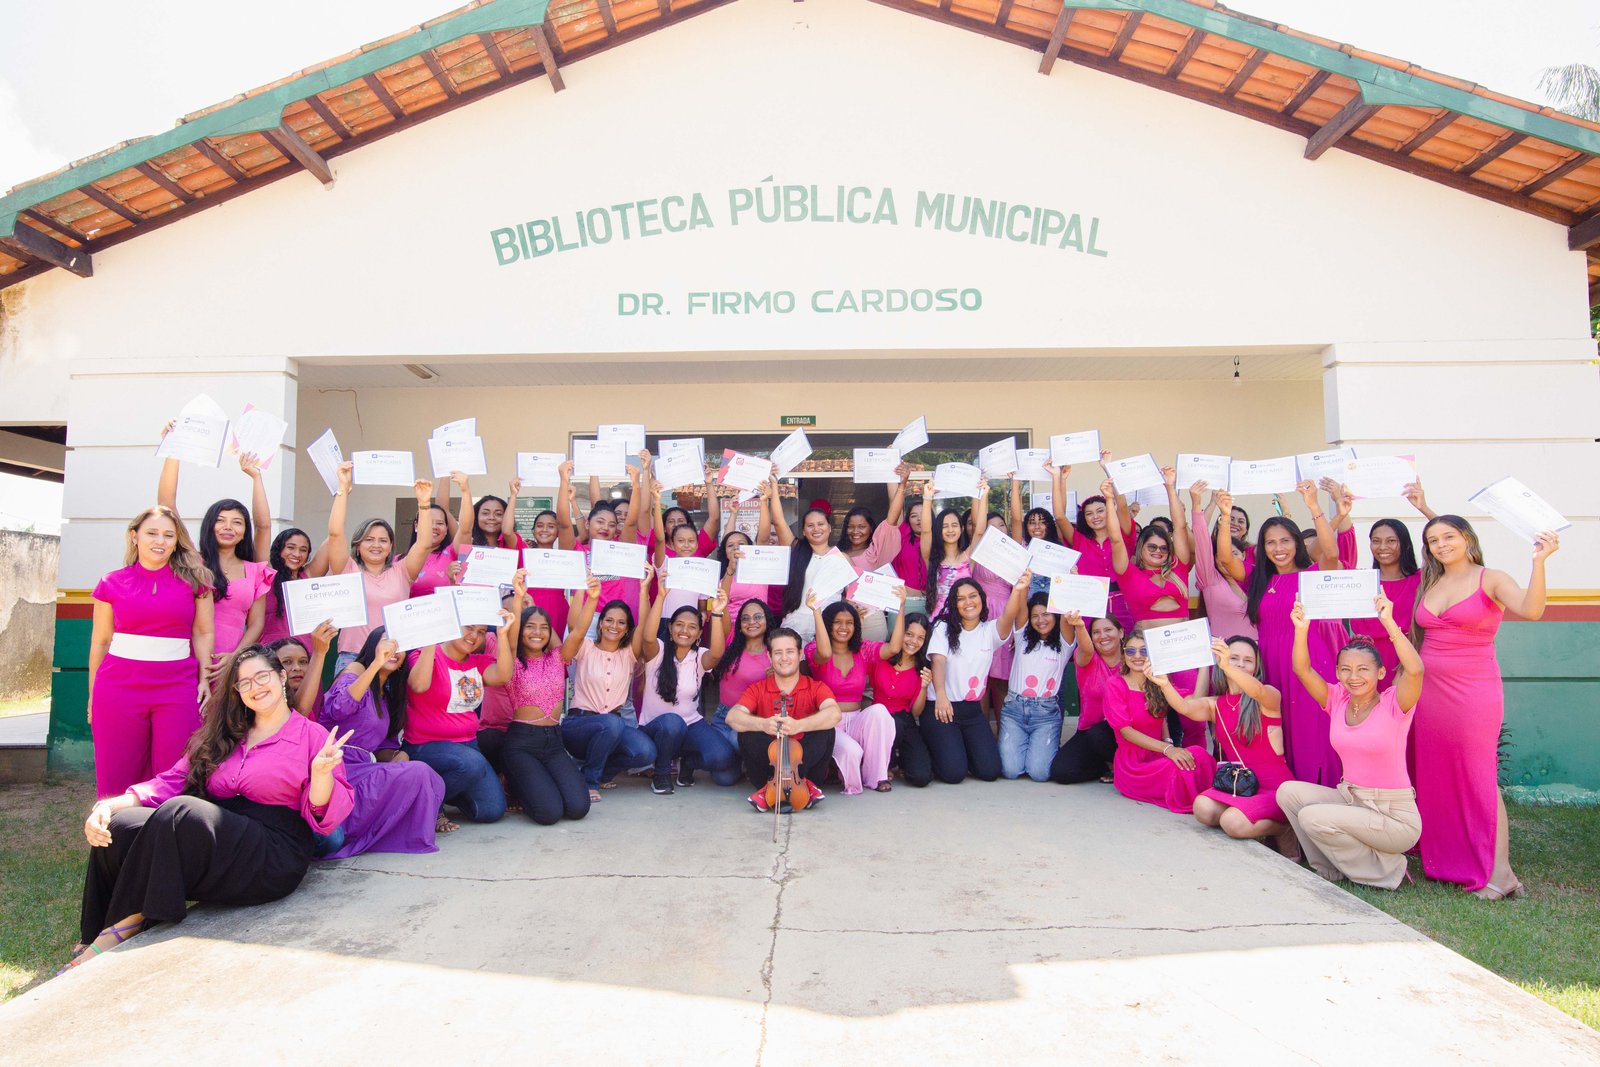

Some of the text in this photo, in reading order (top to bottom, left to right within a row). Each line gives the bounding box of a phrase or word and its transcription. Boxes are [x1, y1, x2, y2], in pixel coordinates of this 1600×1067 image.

[490, 175, 1108, 266] BIBLIOTECA PÚBLICA MUNICIPAL
[617, 288, 983, 316] DR. FIRMO CARDOSO
[1316, 582, 1362, 590] CERTIFICADO
[304, 589, 350, 601] CERTIFICADO
[1160, 633, 1197, 646] CERTIFICADO
